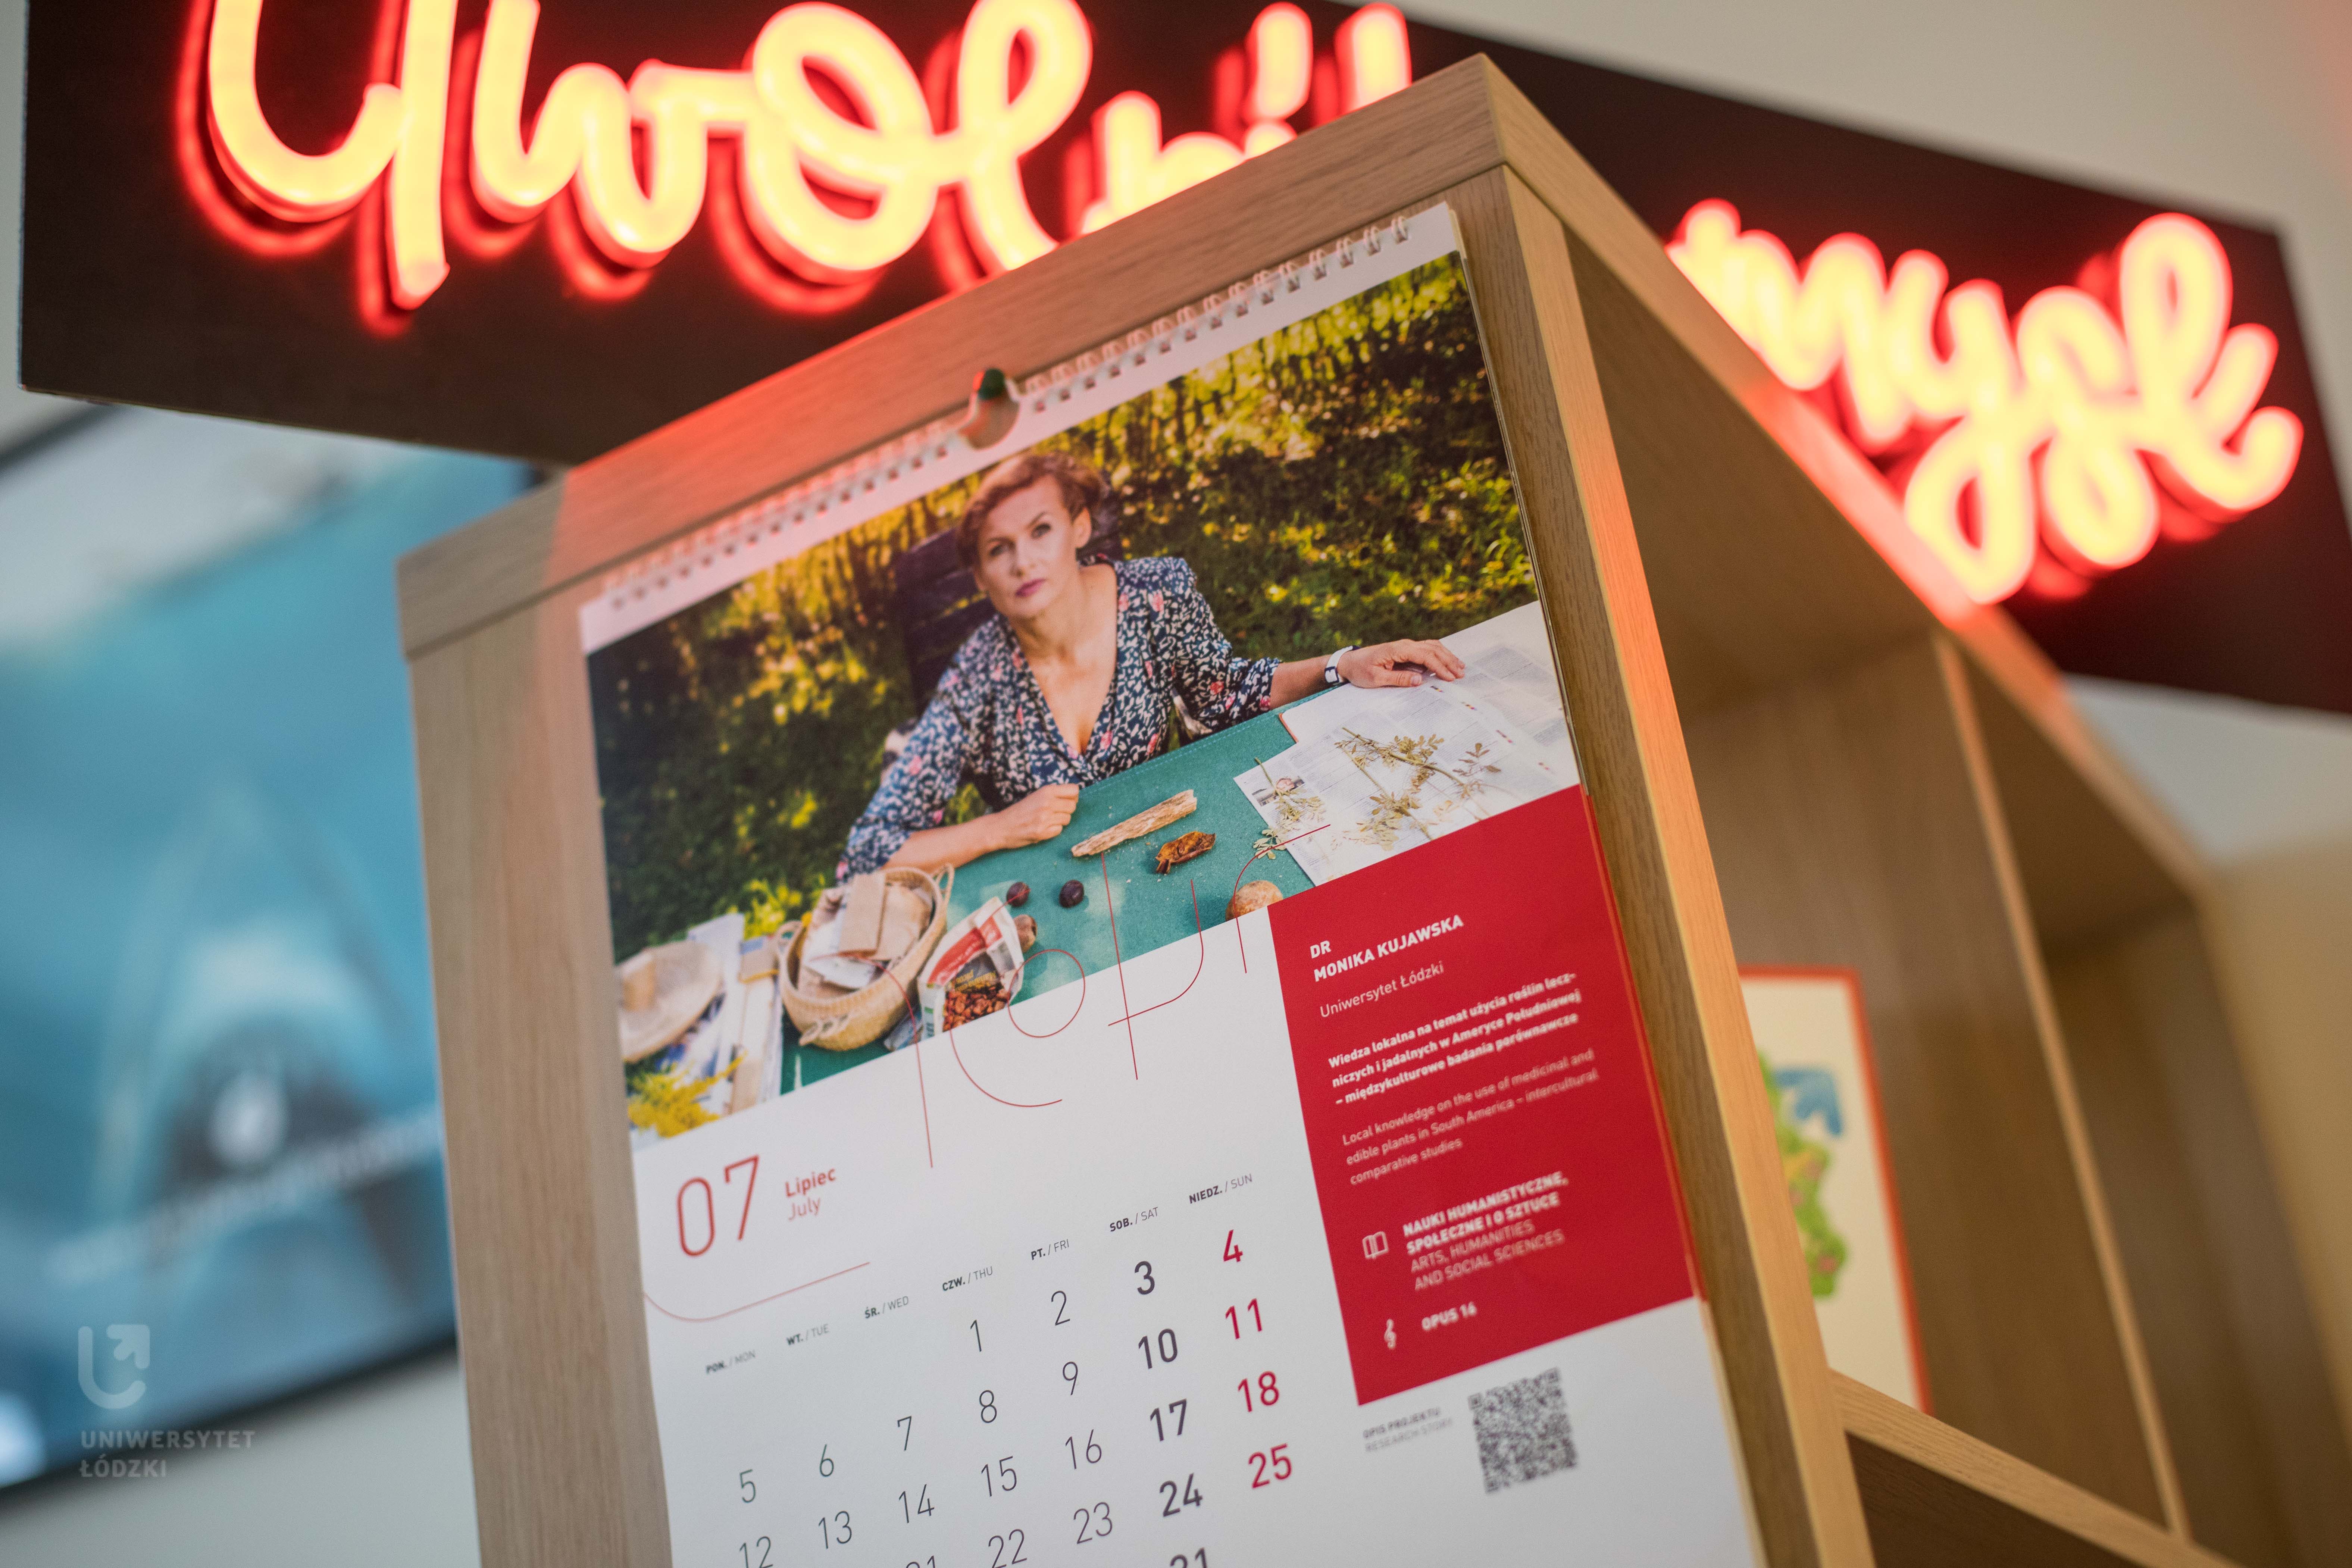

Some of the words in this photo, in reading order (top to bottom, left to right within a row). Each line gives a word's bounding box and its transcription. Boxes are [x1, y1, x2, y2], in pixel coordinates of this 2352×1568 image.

[1310, 940, 1331, 958] DR
[1314, 948, 1375, 982] MONIKA
[1377, 914, 1463, 957] KUJAWSKA
[1320, 980, 1397, 1017] Uniwersytet
[1400, 961, 1444, 988] Łódzki
[1328, 1046, 1371, 1068] Wiedza
[1372, 1030, 1416, 1052] lokalna
[1417, 1024, 1432, 1036] na
[1433, 1009, 1468, 1030] temat
[1469, 996, 1507, 1017] użycia
[1508, 983, 1544, 1002] roślin
[1332, 1064, 1374, 1087] niczych
[1376, 1061, 1380, 1071] i
[1382, 1041, 1438, 1072] jadalnych
[1439, 1037, 1450, 1048] w
[1452, 1018, 1504, 1044] Ameryce
[1505, 989, 1581, 1024] Południowej
[1345, 1060, 1445, 1103] międzykulturowe
[1446, 1042, 1494, 1066] badania
[1495, 1013, 1578, 1051] porównawcze
[1342, 1126, 1373, 1146] Local
[1374, 1105, 1435, 1134] knowledge
[1436, 1099, 1452, 1112] on
[1453, 1092, 1473, 1105] the
[1474, 1084, 1496, 1099] use
[1497, 1076, 1510, 1090] of
[1511, 1057, 1569, 1085] medicinal
[1570, 1048, 1594, 1065] and
[1346, 1146, 1379, 1165] edible
[1381, 1133, 1417, 1155] plants
[1418, 1129, 1429, 1139] in
[1430, 1115, 1465, 1135] South
[1466, 1099, 1514, 1123] America
[1525, 1068, 1598, 1102] intercultural
[785, 1168, 836, 1198] Lipiec
[1350, 1154, 1418, 1185] comparative
[1420, 1138, 1462, 1160] studies
[676, 1155, 759, 1258] 07
[788, 1197, 821, 1221] July
[1402, 1211, 1445, 1237] NAUKI
[1406, 1217, 1484, 1255] SPOŁECZNE
[1485, 1214, 1492, 1227] I
[1493, 1210, 1504, 1224] O
[1505, 1192, 1559, 1220] SZTUCE
[1449, 1219, 1534, 1258] HUMANITIES
[970, 1320, 982, 1352] 1
[1051, 1290, 1070, 1326] 2
[1135, 1261, 1155, 1295] 3
[1223, 1230, 1243, 1262] 4
[1414, 1270, 1444, 1290] AND
[1444, 1254, 1492, 1280] SOCIAL
[1494, 1229, 1564, 1262] SCIENCES
[1421, 1308, 1458, 1331] OPUS
[739, 1469, 756, 1503] 5
[819, 1445, 834, 1477] 6
[897, 1416, 912, 1451] 7
[979, 1390, 997, 1424] 8
[1062, 1361, 1078, 1395] 9
[1138, 1328, 1178, 1369] 10
[1225, 1299, 1262, 1339] 11
[739, 1536, 773, 1568] 12
[819, 1511, 852, 1549] 13
[899, 1484, 935, 1523] 14
[981, 1456, 1017, 1497] 15
[1065, 1429, 1102, 1470] 16
[1150, 1399, 1187, 1441] 17
[1238, 1371, 1279, 1412] 18
[988, 1529, 1027, 1568] 22
[1073, 1502, 1113, 1544] 23
[1160, 1474, 1203, 1517] 24
[1248, 1444, 1292, 1489] 25
